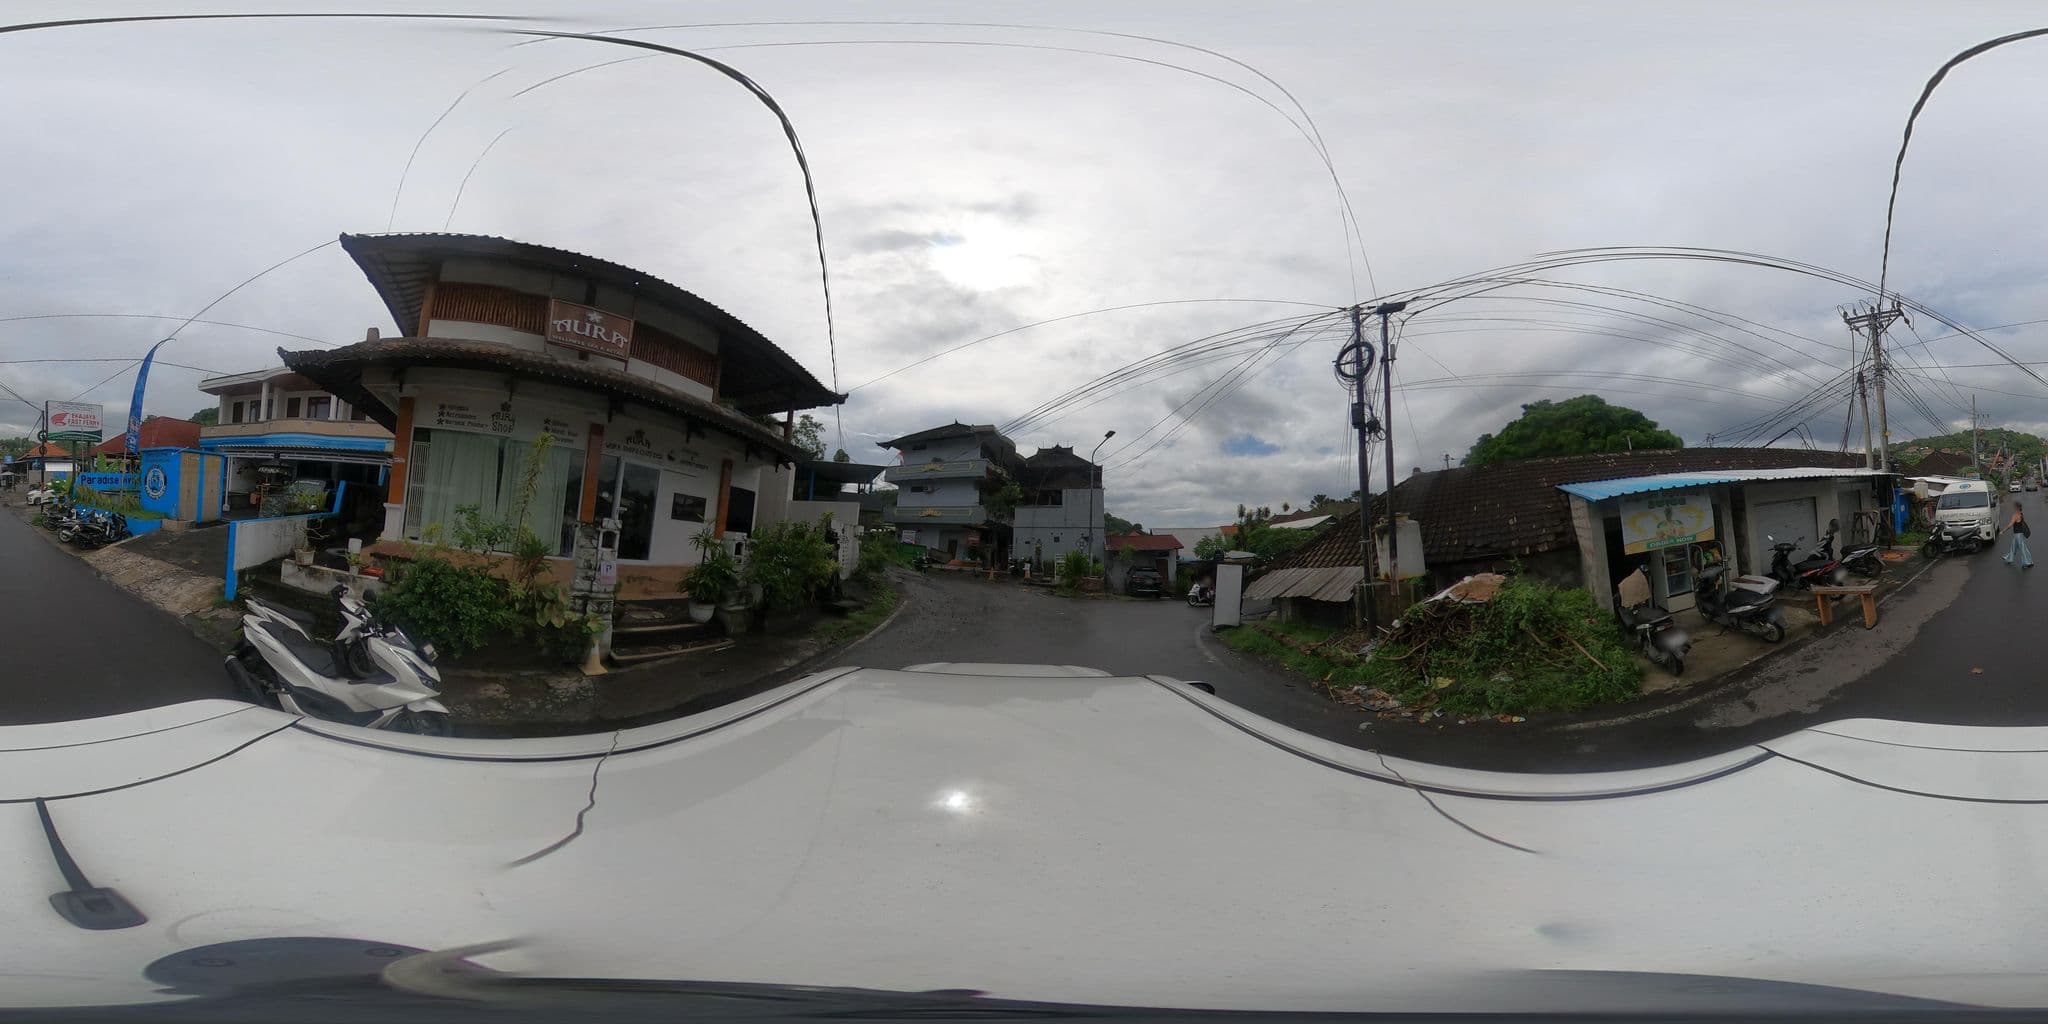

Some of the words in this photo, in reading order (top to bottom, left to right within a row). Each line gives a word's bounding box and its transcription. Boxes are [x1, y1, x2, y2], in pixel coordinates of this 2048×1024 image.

[552, 319, 628, 348] AURA
[83, 419, 99, 427] FERRY
[80, 474, 119, 485] Paradise
